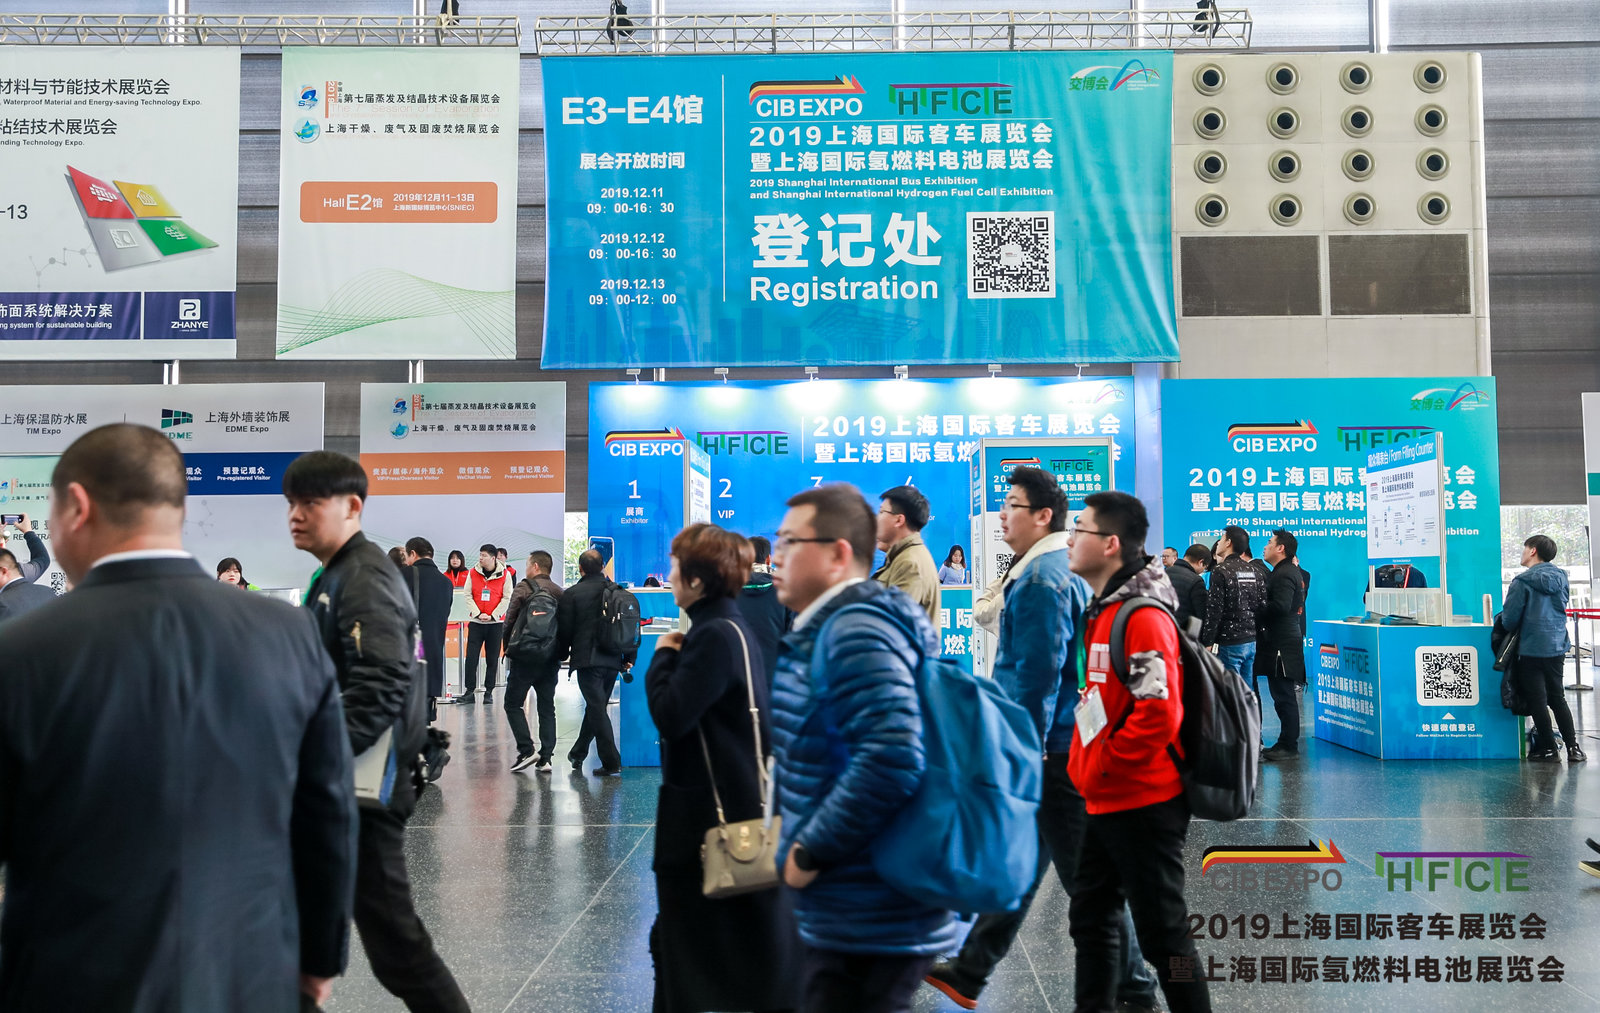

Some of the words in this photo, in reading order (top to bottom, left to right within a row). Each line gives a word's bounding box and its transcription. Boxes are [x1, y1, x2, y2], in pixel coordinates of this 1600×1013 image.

[0, 78, 170, 95] 材料与节能技术展览会
[1069, 76, 1109, 91] 交博会
[89, 99, 139, 107] Energy-saving
[141, 99, 181, 107] Technology
[344, 94, 501, 104] 第七届蒸发及结晶技术设备展览会
[799, 98, 863, 117] EXPO
[750, 122, 1053, 147] 2019上海国际客车展览会
[23, 139, 63, 147] Technology
[580, 152, 685, 170] 展会开放时间
[750, 148, 1054, 173] 暨上海国际氢燃料电池展览会
[750, 179, 774, 187] 2019
[777, 179, 826, 189] Shanghai
[829, 178, 898, 187] International
[901, 177, 922, 186] Bus
[924, 176, 978, 185] Exhibition
[393, 193, 475, 202] 2019年12月11-13日
[600, 187, 664, 199] 2019.12.11
[750, 190, 769, 199] and
[772, 190, 821, 200] Shanghai
[824, 189, 894, 198] International
[896, 188, 948, 199] Hydrogen
[951, 187, 974, 197] Fuel
[976, 187, 997, 196] Cell
[1000, 186, 1054, 196] Exhibition
[323, 197, 345, 208] Hall
[600, 233, 665, 245] 2019.12.12
[751, 212, 942, 268] 登记处
[600, 279, 665, 290] 2019.12.13
[750, 275, 938, 307] Registration
[10, 322, 34, 330] system
[86, 322, 112, 330] building
[171, 321, 209, 329] ZHANYE
[1, 413, 88, 425] 上海保温防水展
[205, 410, 290, 423] 上海外墙装饰展
[226, 425, 248, 433] EDME
[250, 425, 269, 434] Expo
[813, 413, 1121, 437] 2019上海国际客车展览会
[26, 427, 40, 435] TIM
[42, 427, 61, 436] Expo
[1266, 437, 1317, 452] EXPO
[223, 466, 265, 475] 预登记观众
[628, 479, 641, 499] 1
[718, 478, 733, 498] 2
[625, 507, 644, 516] 展商
[718, 510, 735, 519] VIP
[1226, 518, 1249, 526] 2019
[1252, 517, 1298, 528] Shanghai
[1301, 516, 1366, 526] International
[1330, 527, 1368, 539] Hydrog
